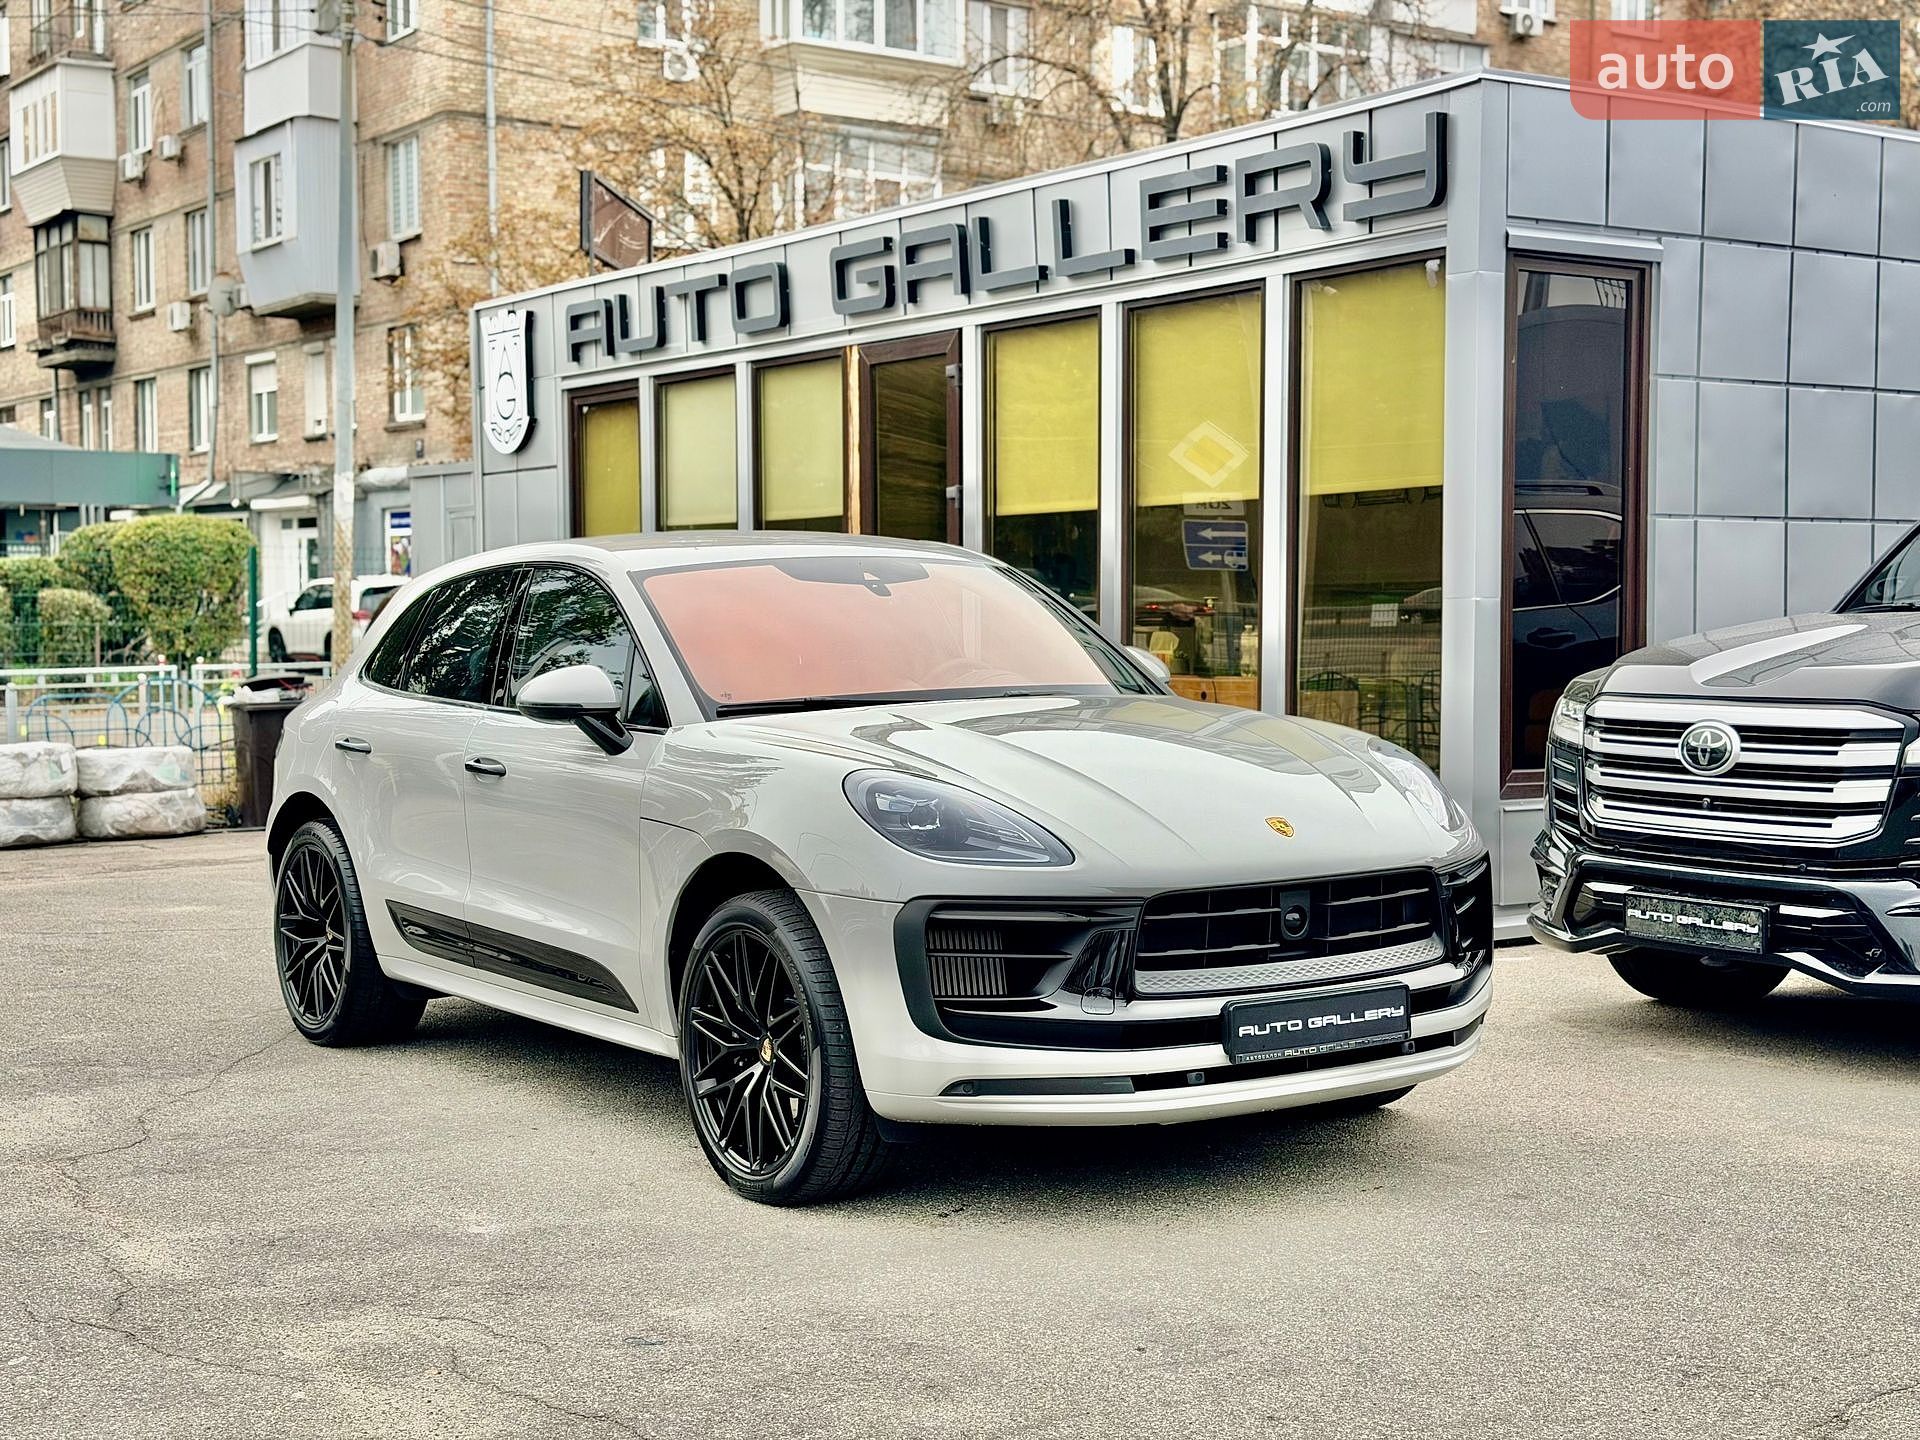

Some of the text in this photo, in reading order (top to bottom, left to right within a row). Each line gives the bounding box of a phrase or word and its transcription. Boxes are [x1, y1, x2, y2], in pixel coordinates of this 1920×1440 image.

[566, 111, 1448, 364] AUTO GALLERY
[1627, 909, 1758, 933] AUTO GALLERY
[1238, 1005, 1404, 1037] AUTO GALLERY
[1284, 1046, 1317, 1057] AUTO
